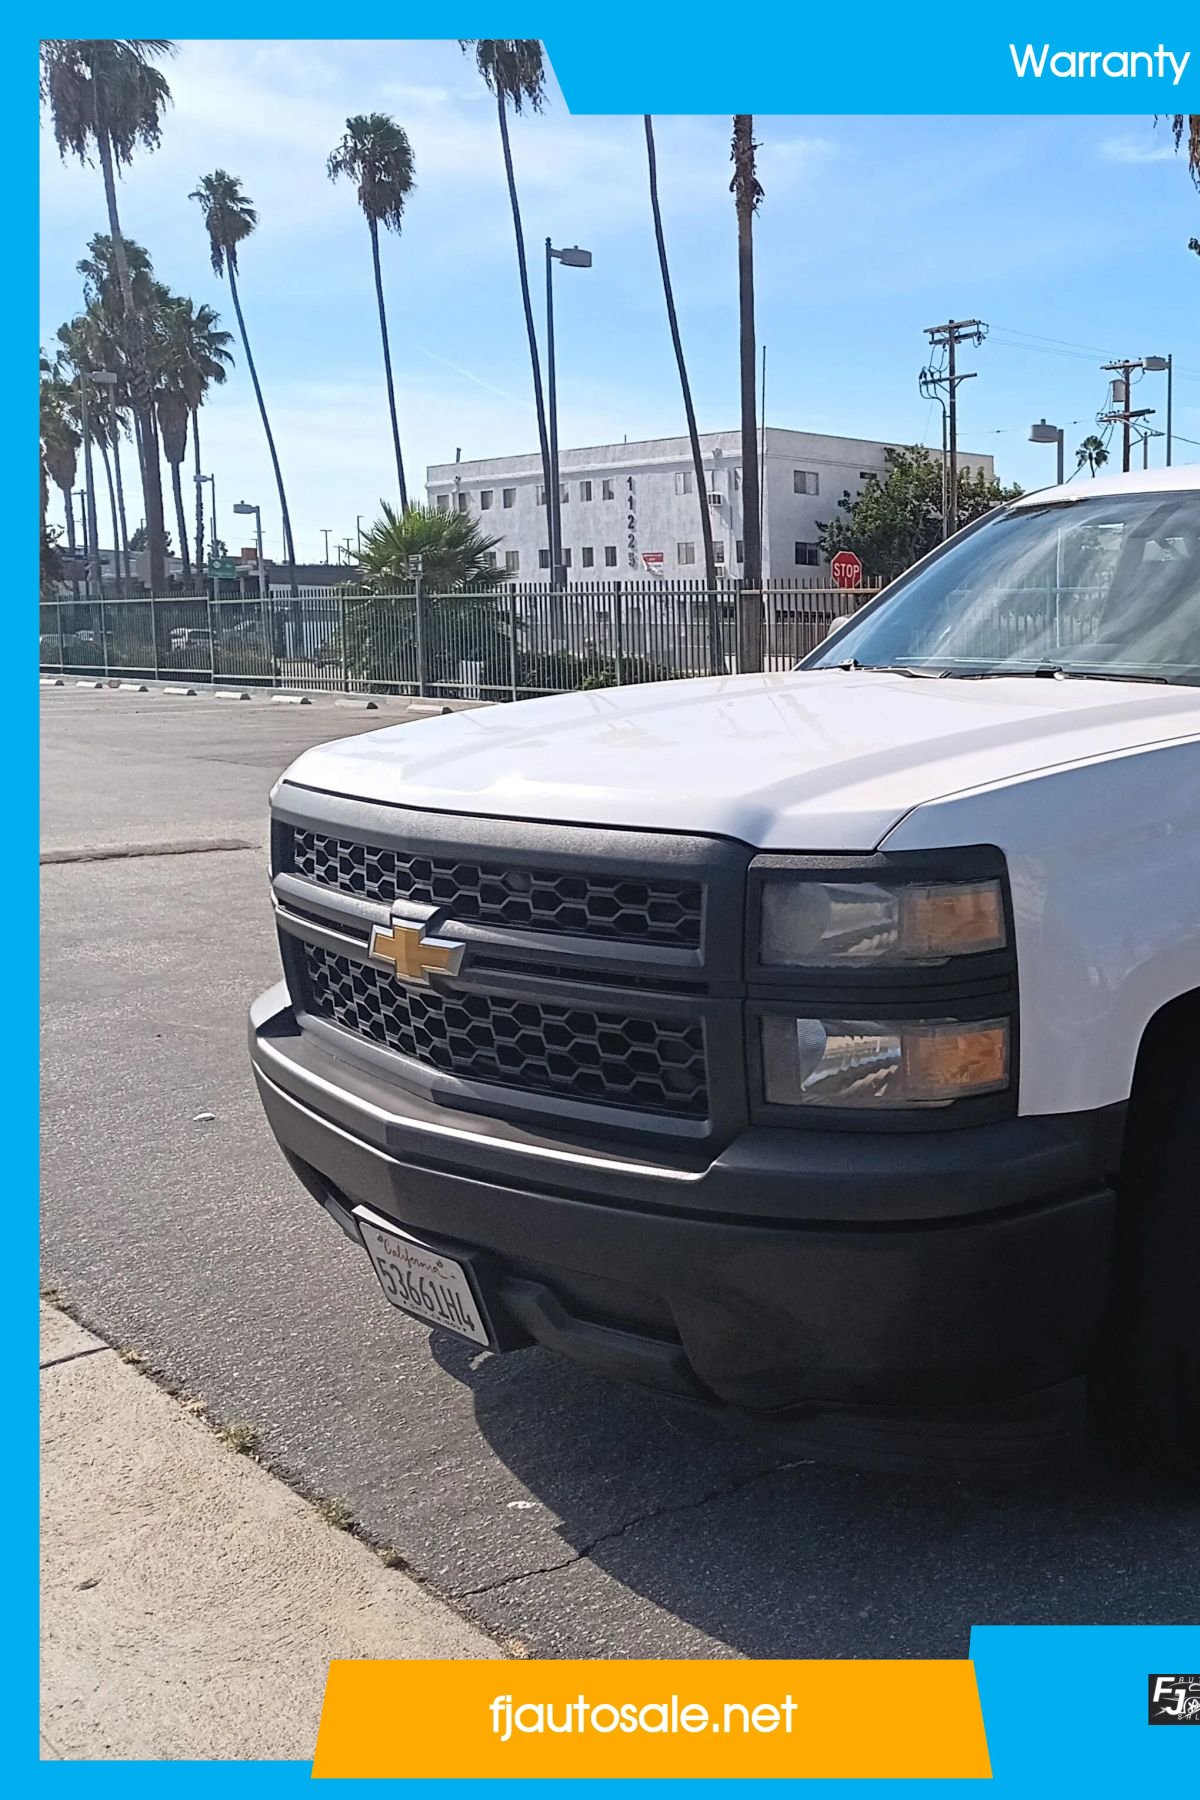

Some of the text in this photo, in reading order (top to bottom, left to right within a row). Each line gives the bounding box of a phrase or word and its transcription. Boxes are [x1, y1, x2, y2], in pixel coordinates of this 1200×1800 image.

[627, 476, 636, 568] 11225
[833, 562, 860, 578] STOP
[384, 1239, 440, 1274] California
